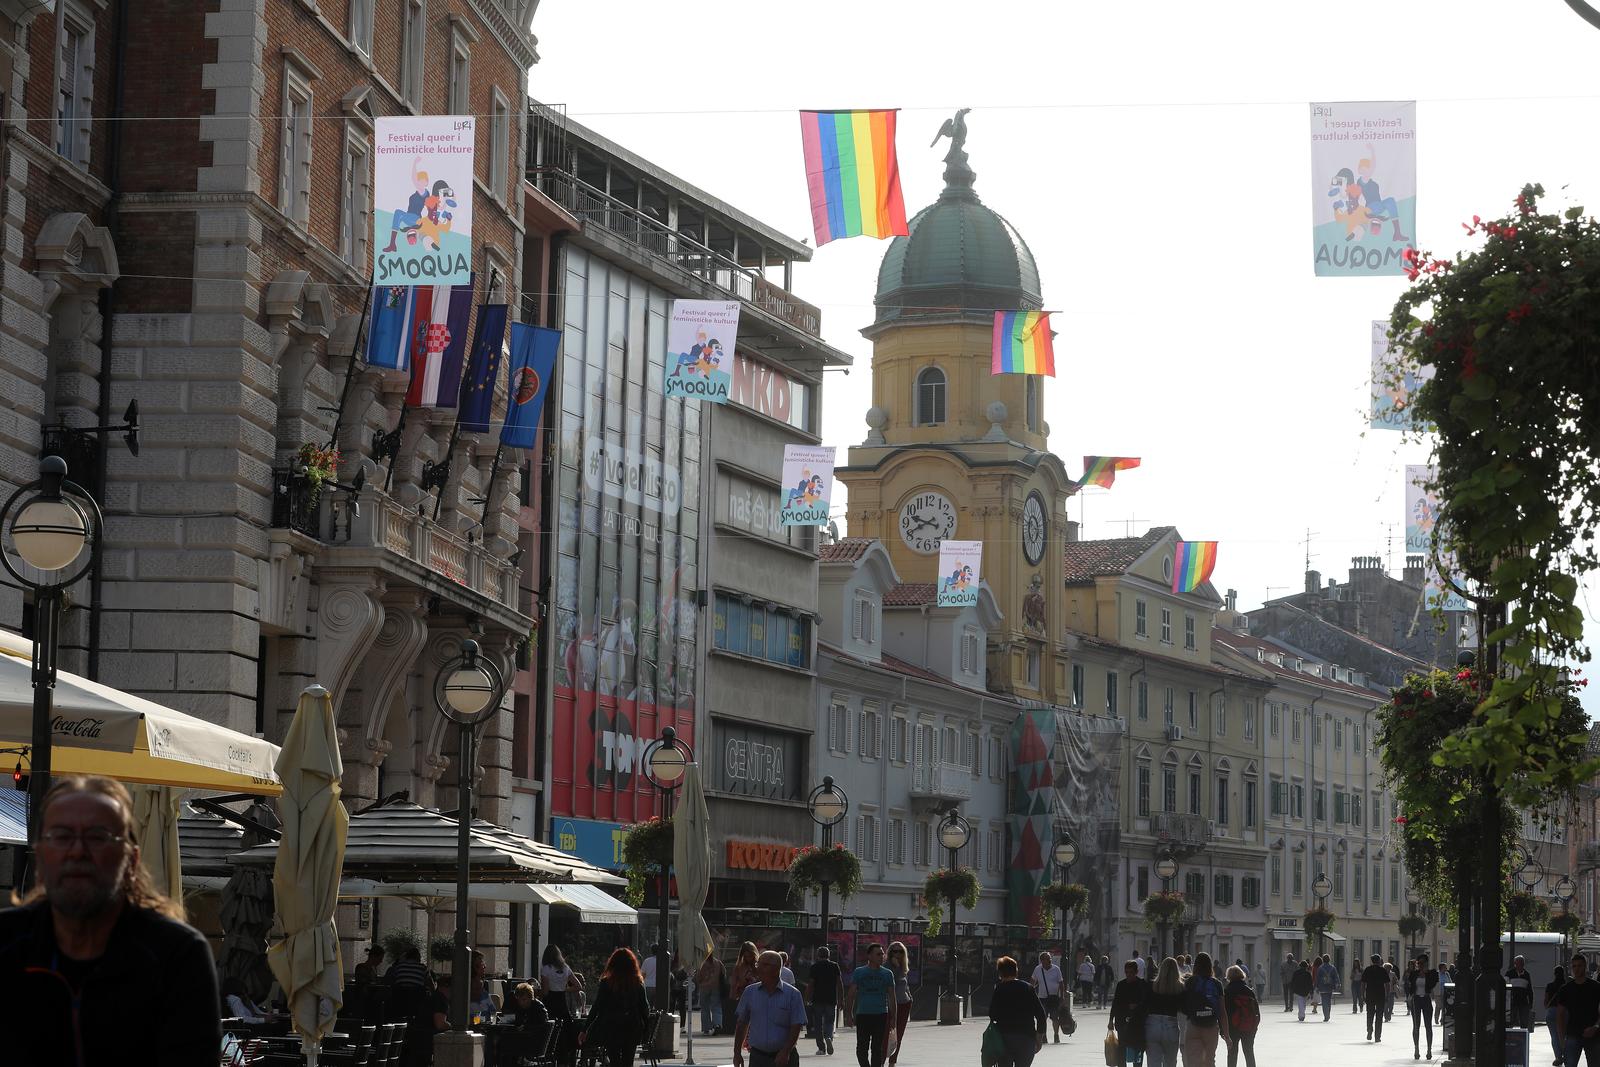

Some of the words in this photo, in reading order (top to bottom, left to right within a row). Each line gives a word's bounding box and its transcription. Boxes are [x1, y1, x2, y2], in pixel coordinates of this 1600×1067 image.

[388, 133, 424, 142] Festival
[427, 134, 455, 143] queer
[377, 145, 435, 154] feminističke
[437, 145, 472, 154] kulture
[378, 253, 469, 280] SMOQUA
[666, 378, 727, 396] SMOQUA
[731, 351, 791, 425] NKD
[916, 498, 923, 510] 11
[925, 495, 935, 507] 12
[938, 498, 942, 510] 1
[907, 504, 916, 516] 10
[943, 504, 950, 515] 2
[781, 510, 828, 524] SMOQUA
[902, 517, 909, 528] 9
[947, 516, 954, 528] 3
[906, 529, 914, 541] 8
[942, 528, 949, 540] 4
[916, 537, 923, 549] 7
[924, 539, 931, 551] 6
[934, 536, 941, 549] 5
[938, 594, 977, 605] SMOQUA
[51, 716, 105, 738] Coca-Cola
[726, 738, 784, 786] CENTRA
